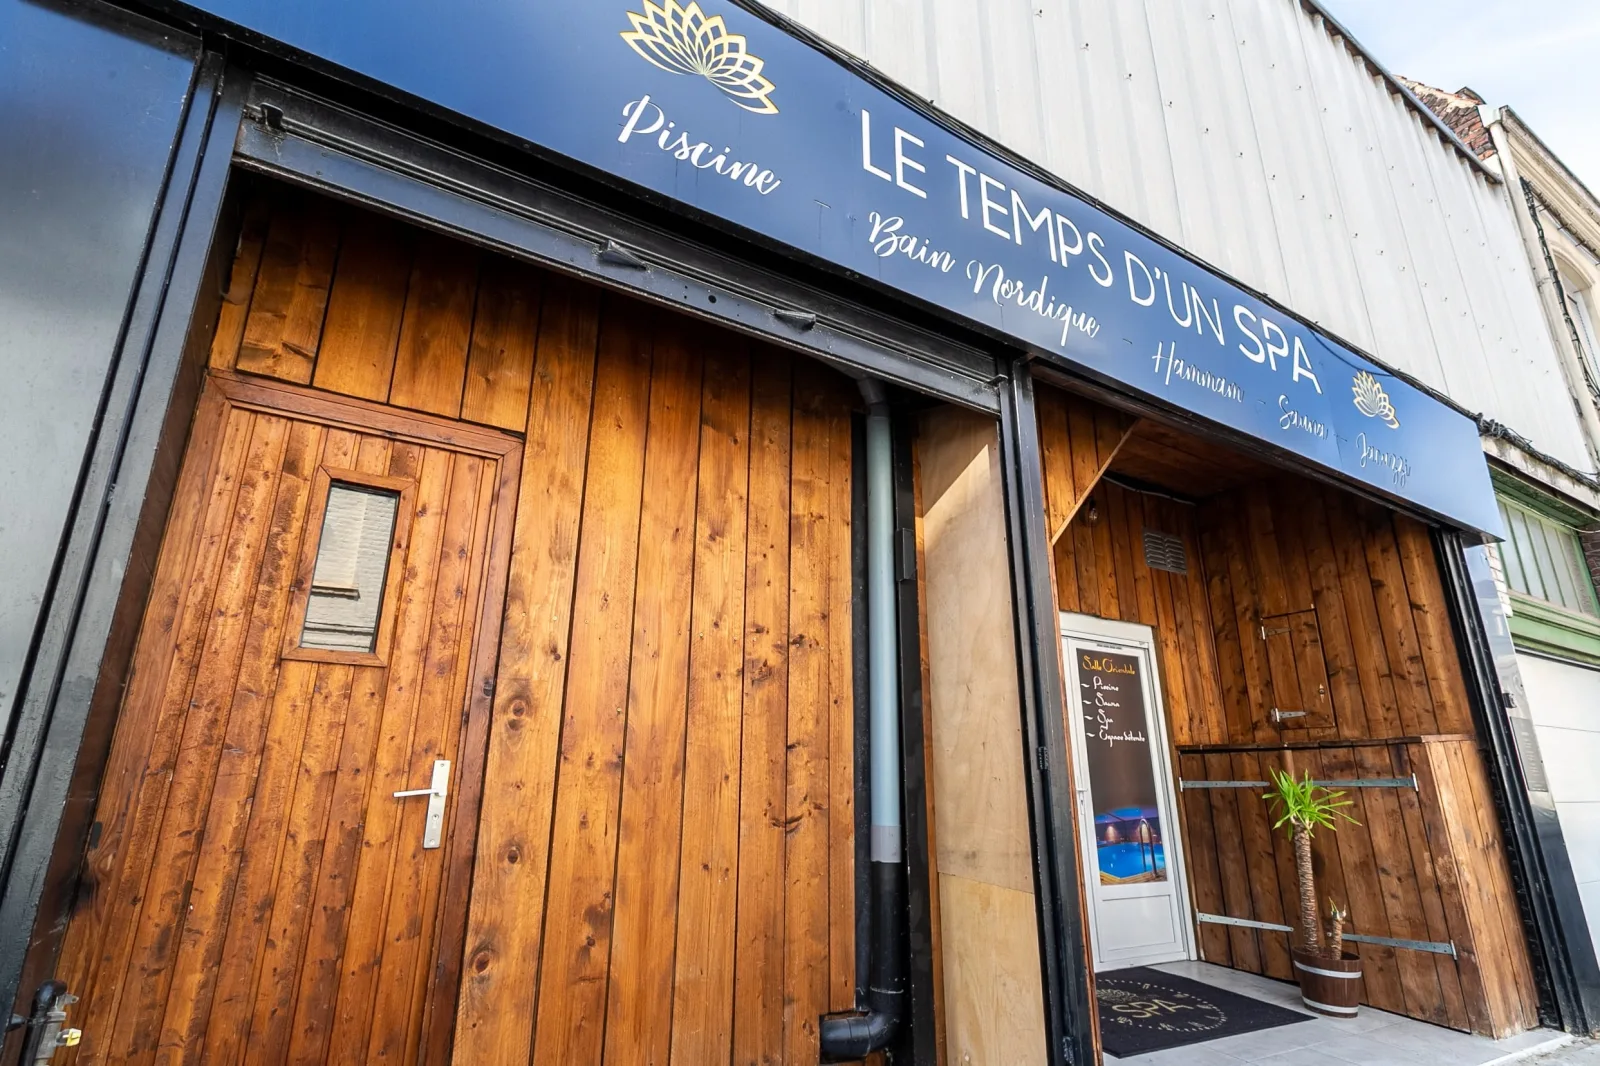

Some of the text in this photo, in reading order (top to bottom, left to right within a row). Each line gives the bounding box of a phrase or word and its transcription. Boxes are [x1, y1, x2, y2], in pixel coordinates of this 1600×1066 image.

[617, 94, 782, 196] Piscine
[861, 108, 1324, 395] LE TEMPS D'UN SPA
[868, 211, 1101, 347] Bain Nordique
[1152, 340, 1245, 403] Hammam
[1278, 394, 1329, 441] Sauna
[1097, 708, 1114, 730] Spa
[1111, 998, 1195, 1019] SPA
